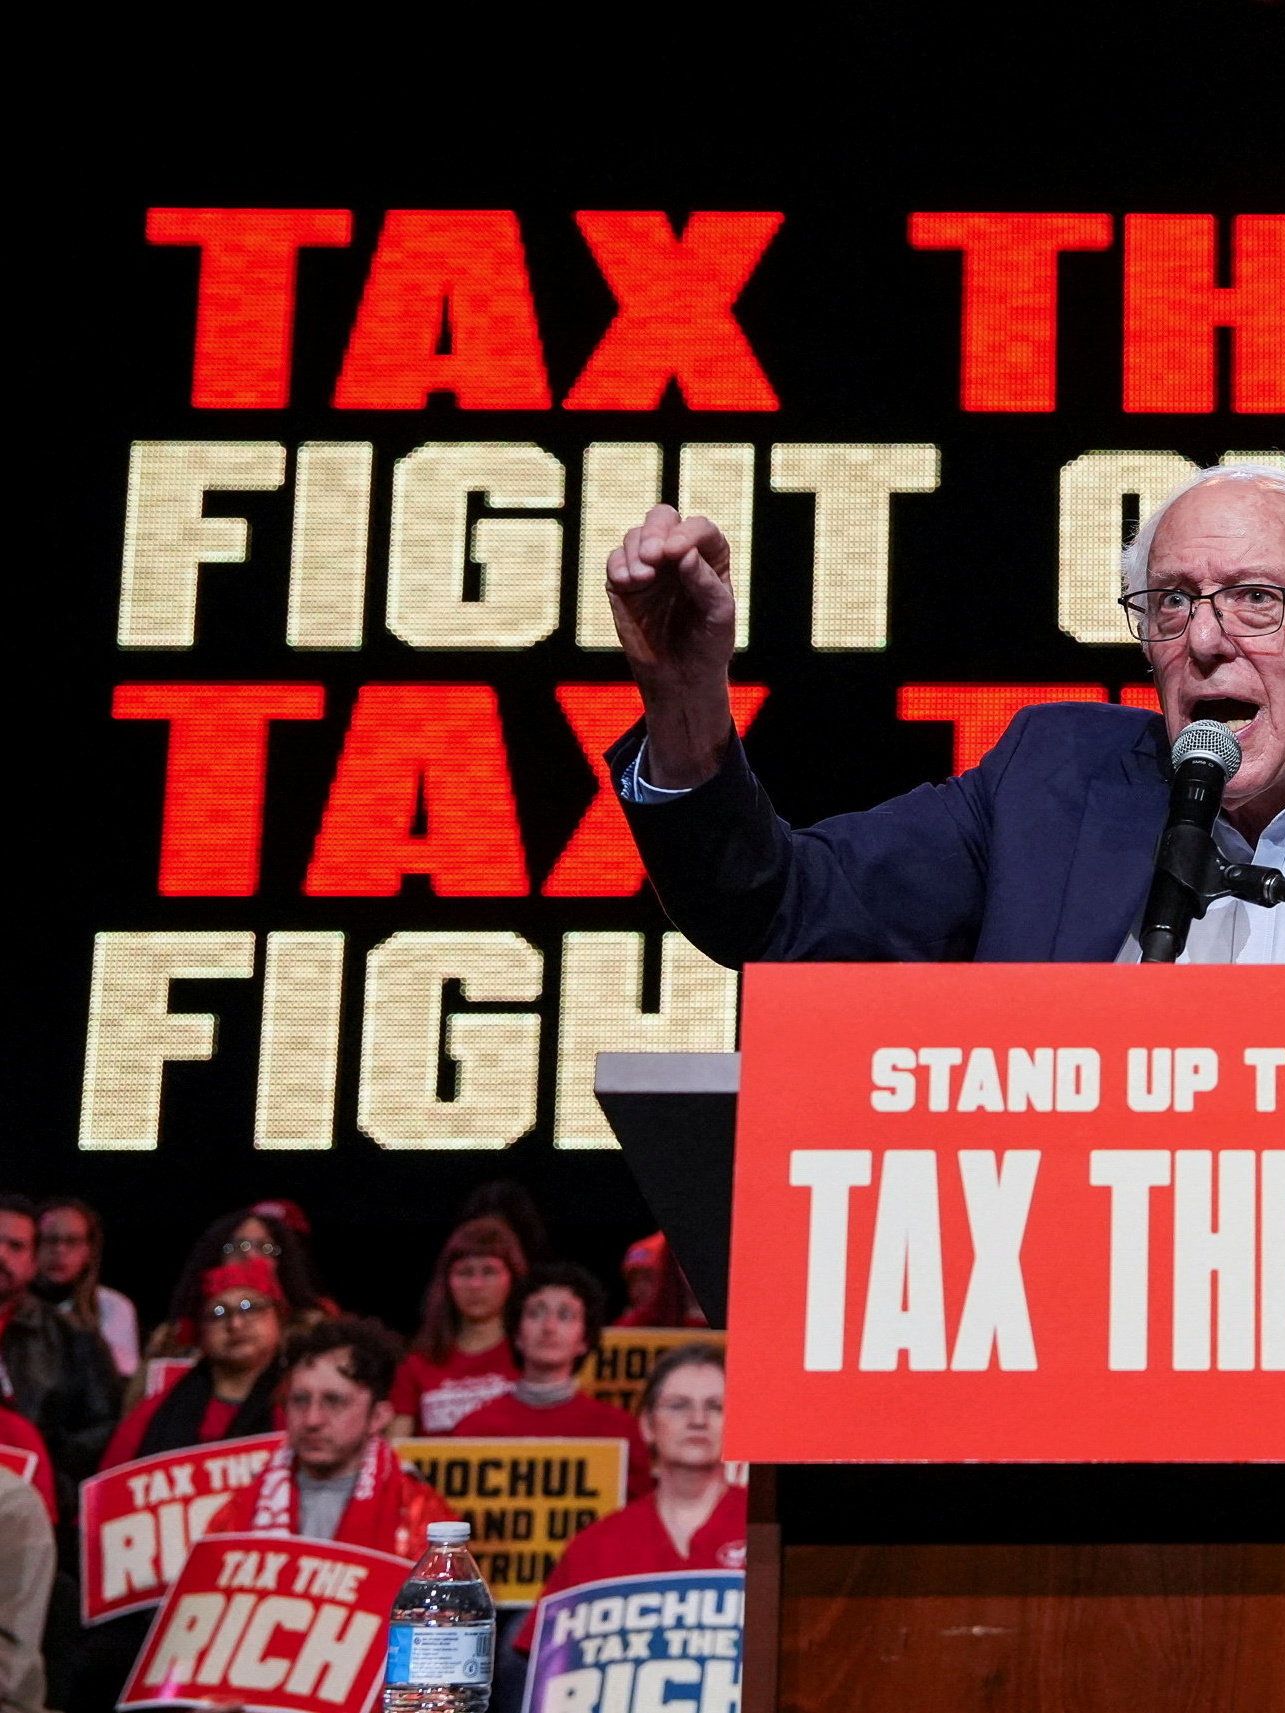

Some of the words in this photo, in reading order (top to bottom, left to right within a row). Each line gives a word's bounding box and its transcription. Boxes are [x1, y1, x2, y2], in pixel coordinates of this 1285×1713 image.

[146, 208, 784, 411] TAX
[117, 440, 941, 650] FIGHT
[78, 931, 738, 1150] FIGH
[869, 1047, 1102, 1113] STAND
[1126, 1047, 1220, 1113] UP
[788, 1149, 1042, 1373] TAX
[127, 1462, 196, 1509] TAX
[215, 1550, 289, 1591] TAX
[293, 1554, 369, 1606] THE
[553, 1588, 745, 1647] HOCHU
[143, 1592, 383, 1705] RICH
[579, 1629, 652, 1667] TAX
[662, 1627, 741, 1659] THE
